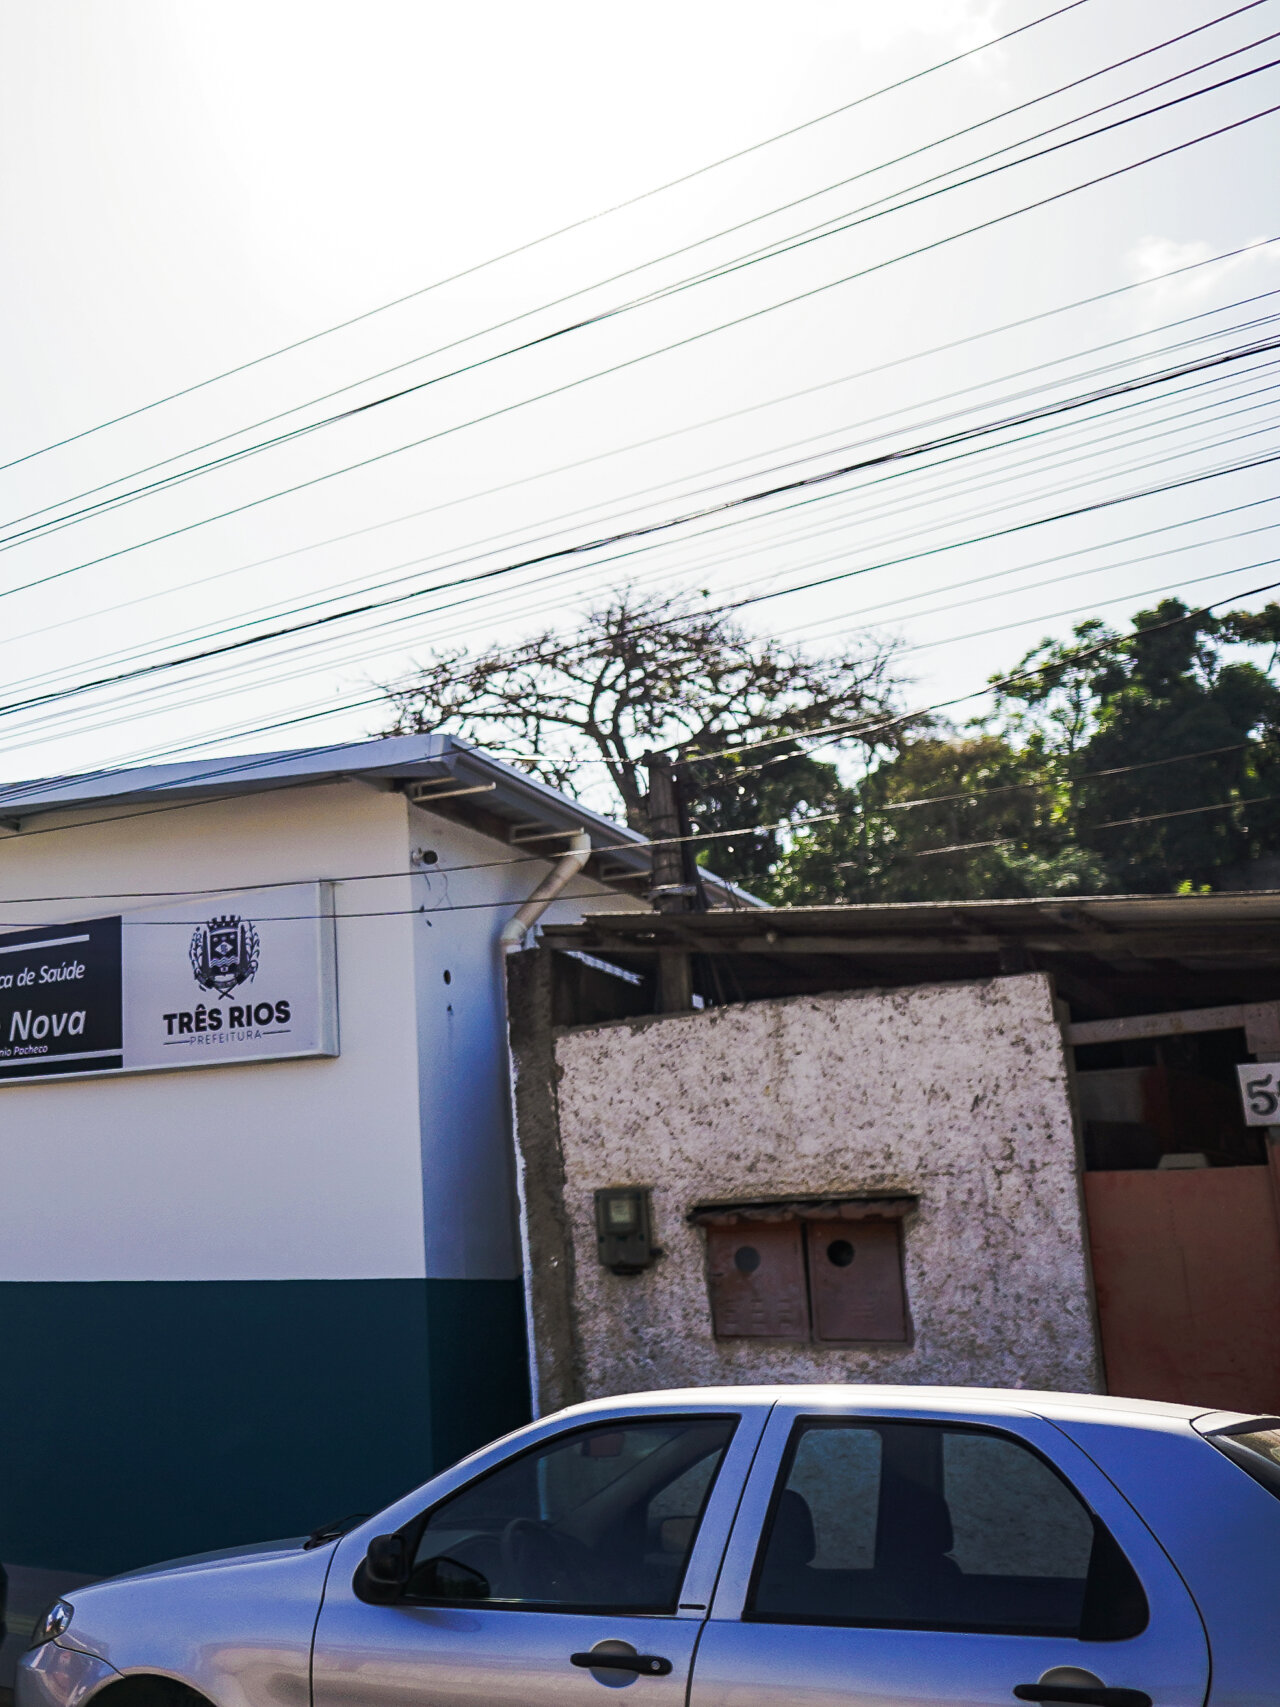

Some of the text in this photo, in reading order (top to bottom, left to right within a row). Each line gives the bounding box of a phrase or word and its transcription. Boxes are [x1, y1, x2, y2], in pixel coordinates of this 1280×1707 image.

[17, 968, 36, 985] de
[39, 960, 86, 983] Saúde
[9, 1009, 87, 1041] Nova
[163, 1000, 291, 1035] TRÊS RIOS
[13, 1044, 48, 1056] Pacheco
[190, 1030, 261, 1045] PREFEITURA
[1246, 1073, 1280, 1116] 5
